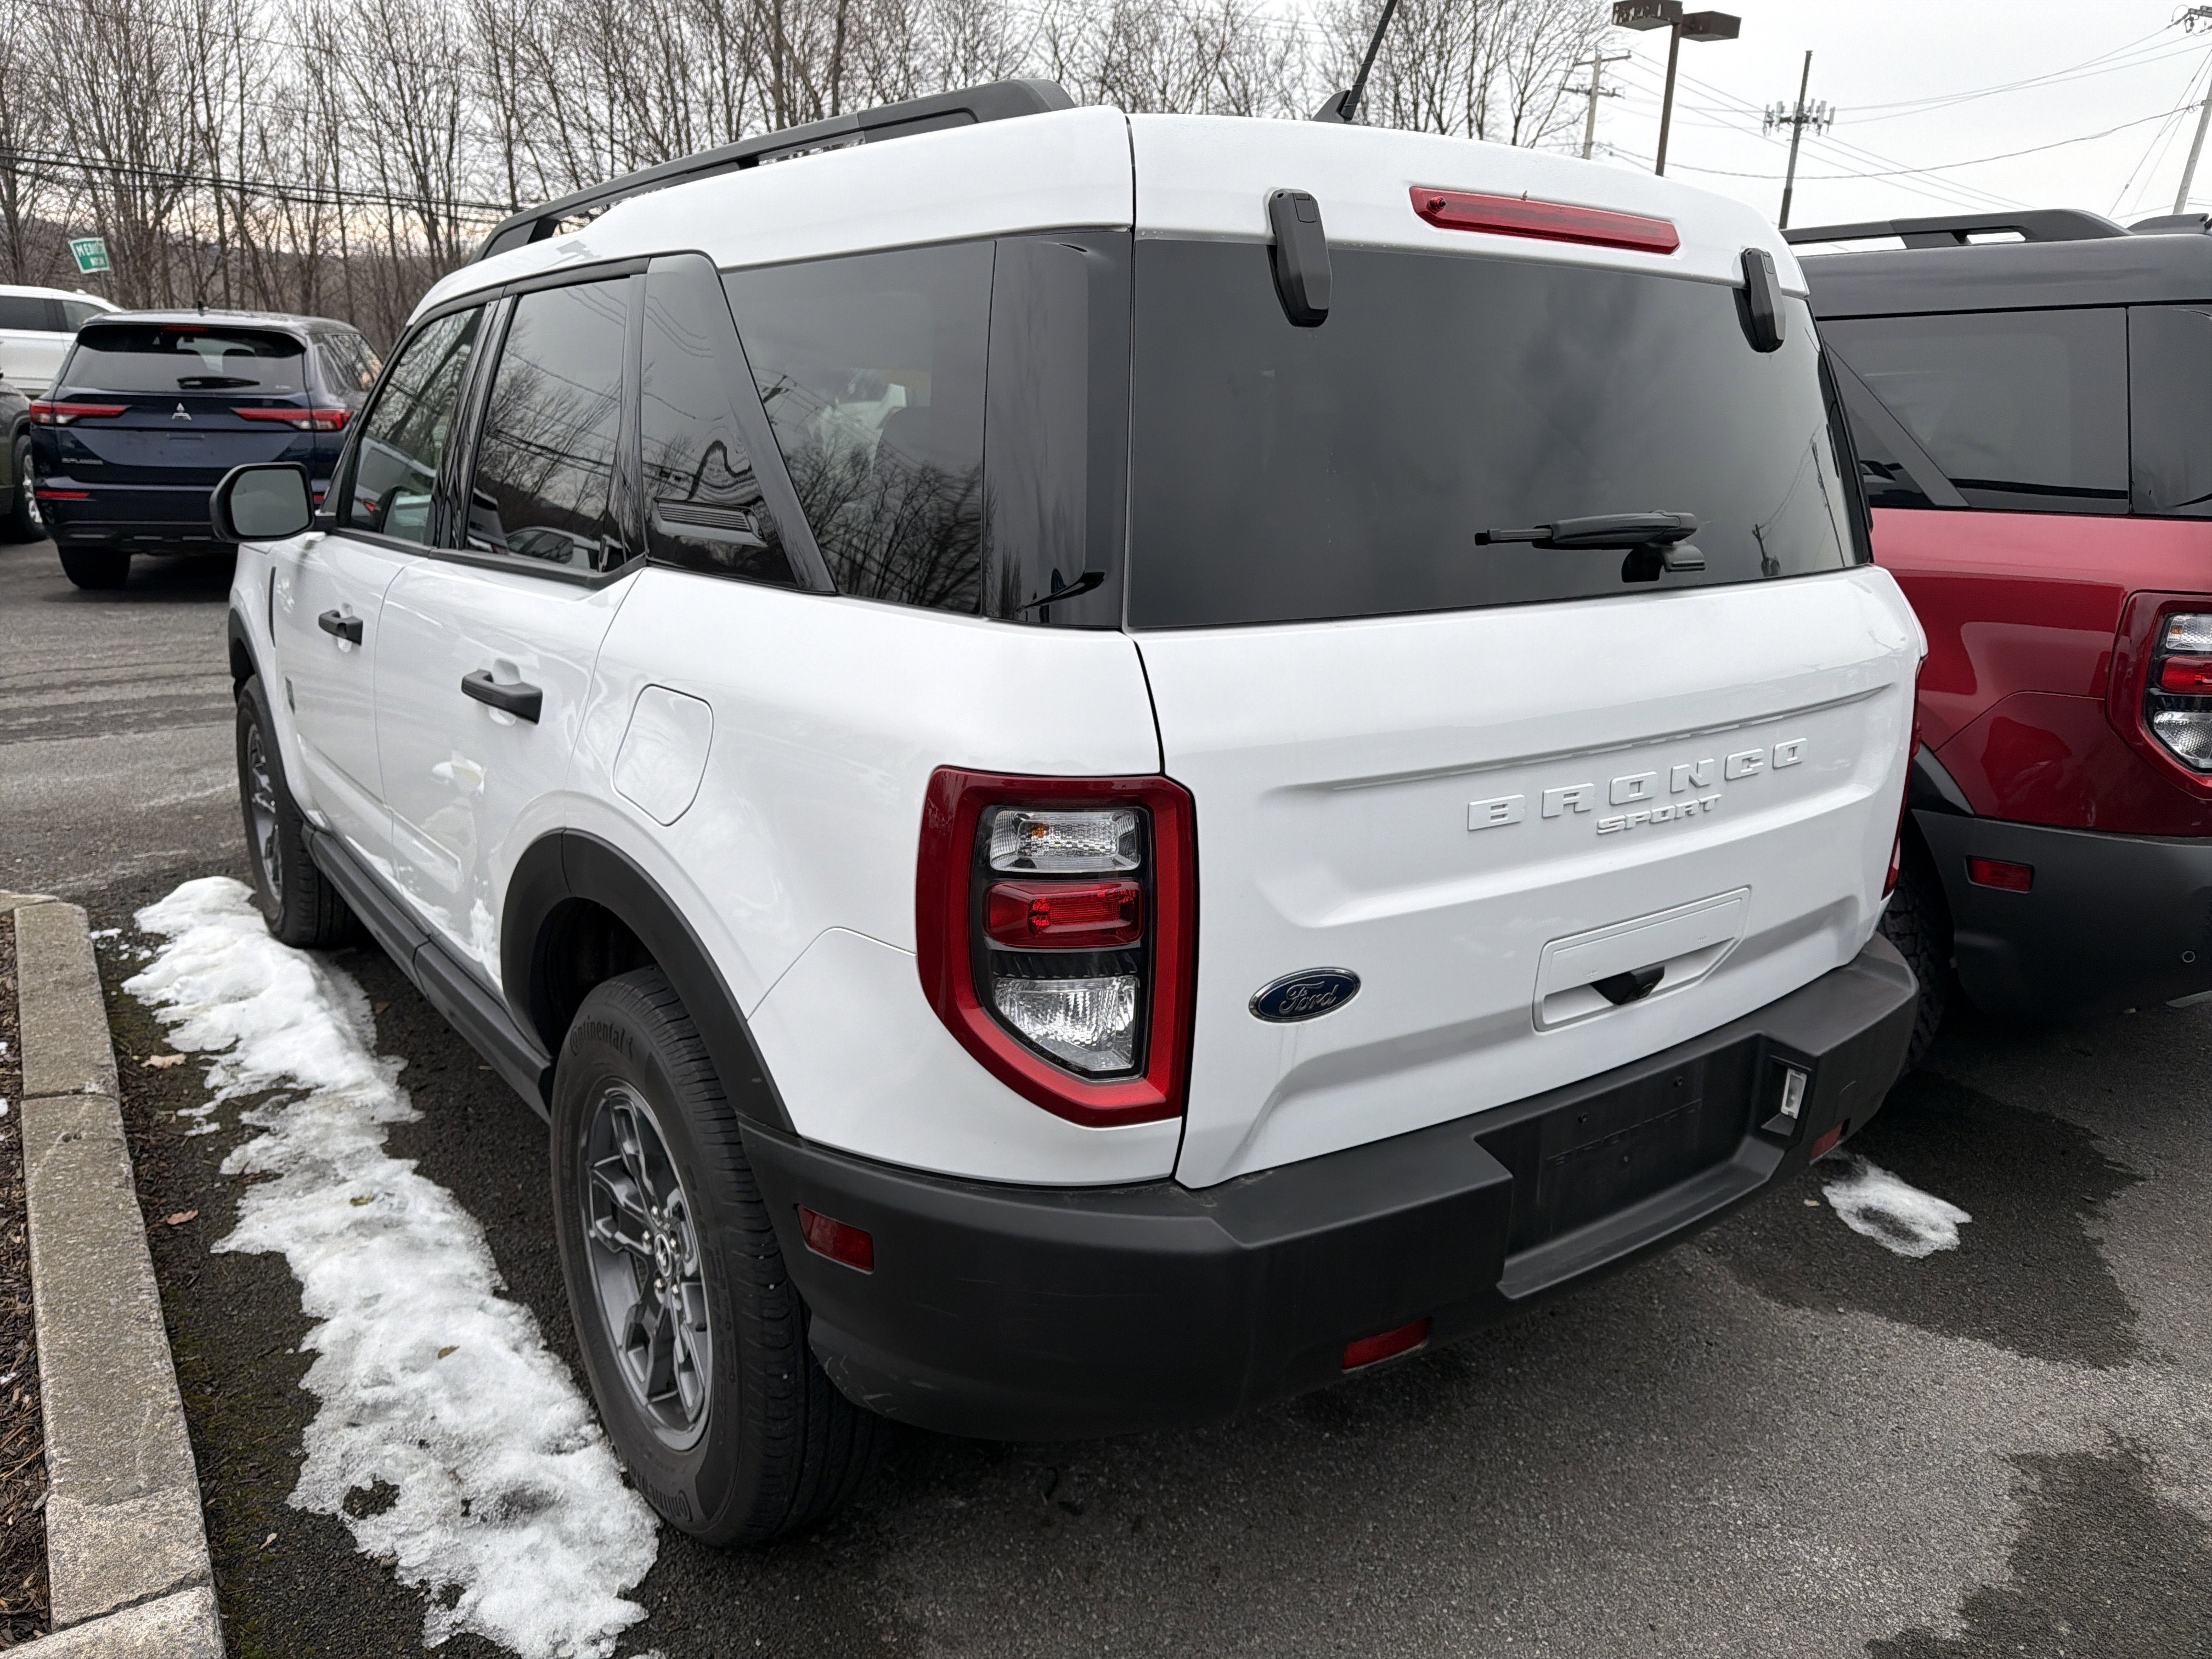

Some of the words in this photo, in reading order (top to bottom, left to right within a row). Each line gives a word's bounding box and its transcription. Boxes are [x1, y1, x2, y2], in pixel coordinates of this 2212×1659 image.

[1467, 737, 1808, 832] BRONCO
[1596, 793, 1722, 834] SPORT
[1279, 980, 1339, 1014] Ford
[569, 1014, 625, 1057] Continental
